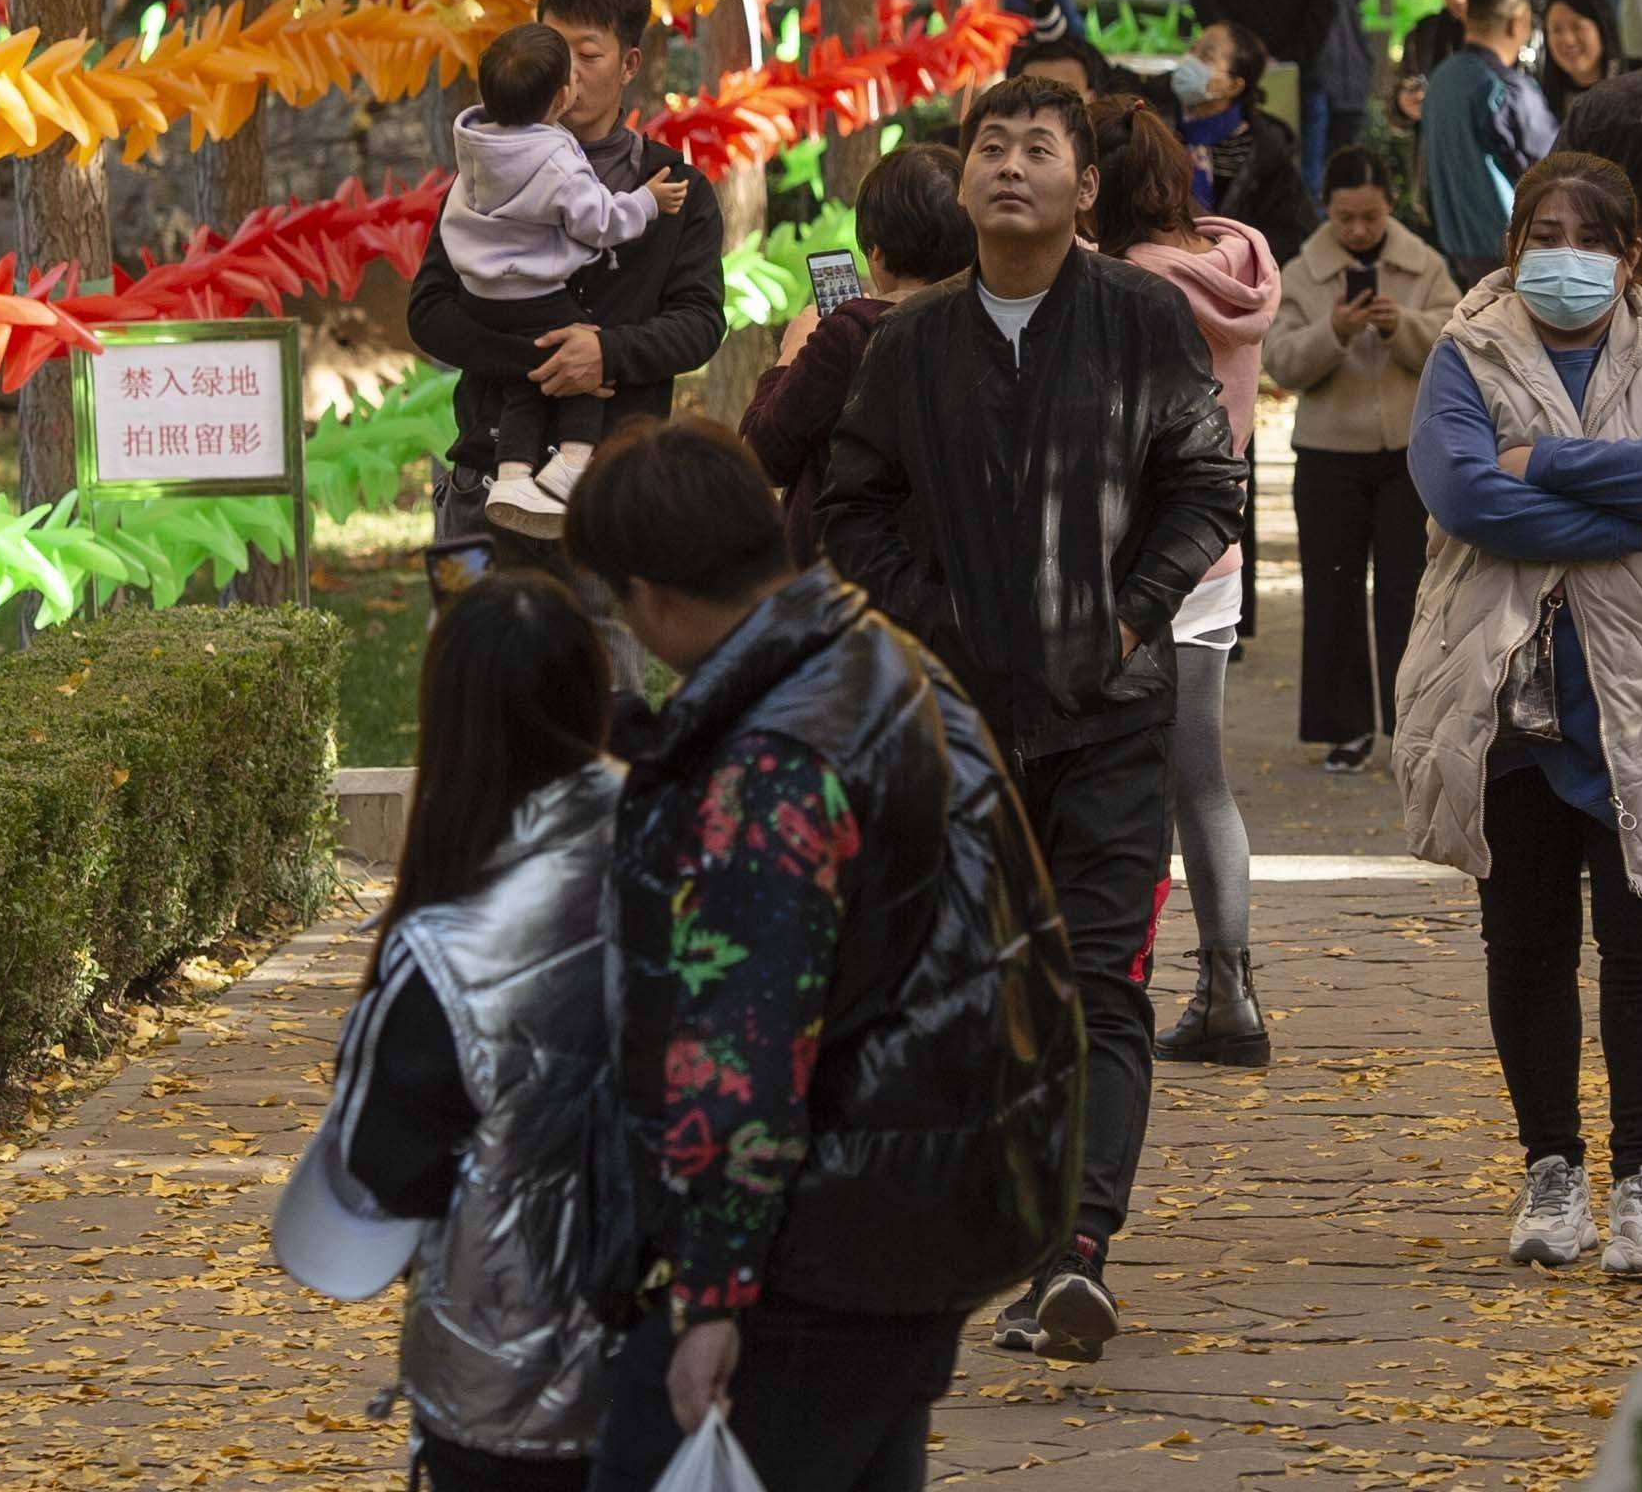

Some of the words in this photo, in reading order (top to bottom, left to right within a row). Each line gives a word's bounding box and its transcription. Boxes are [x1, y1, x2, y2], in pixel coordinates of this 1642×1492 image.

[120, 364, 260, 399] 禁入绿地
[123, 422, 261, 458] 拍照留影
